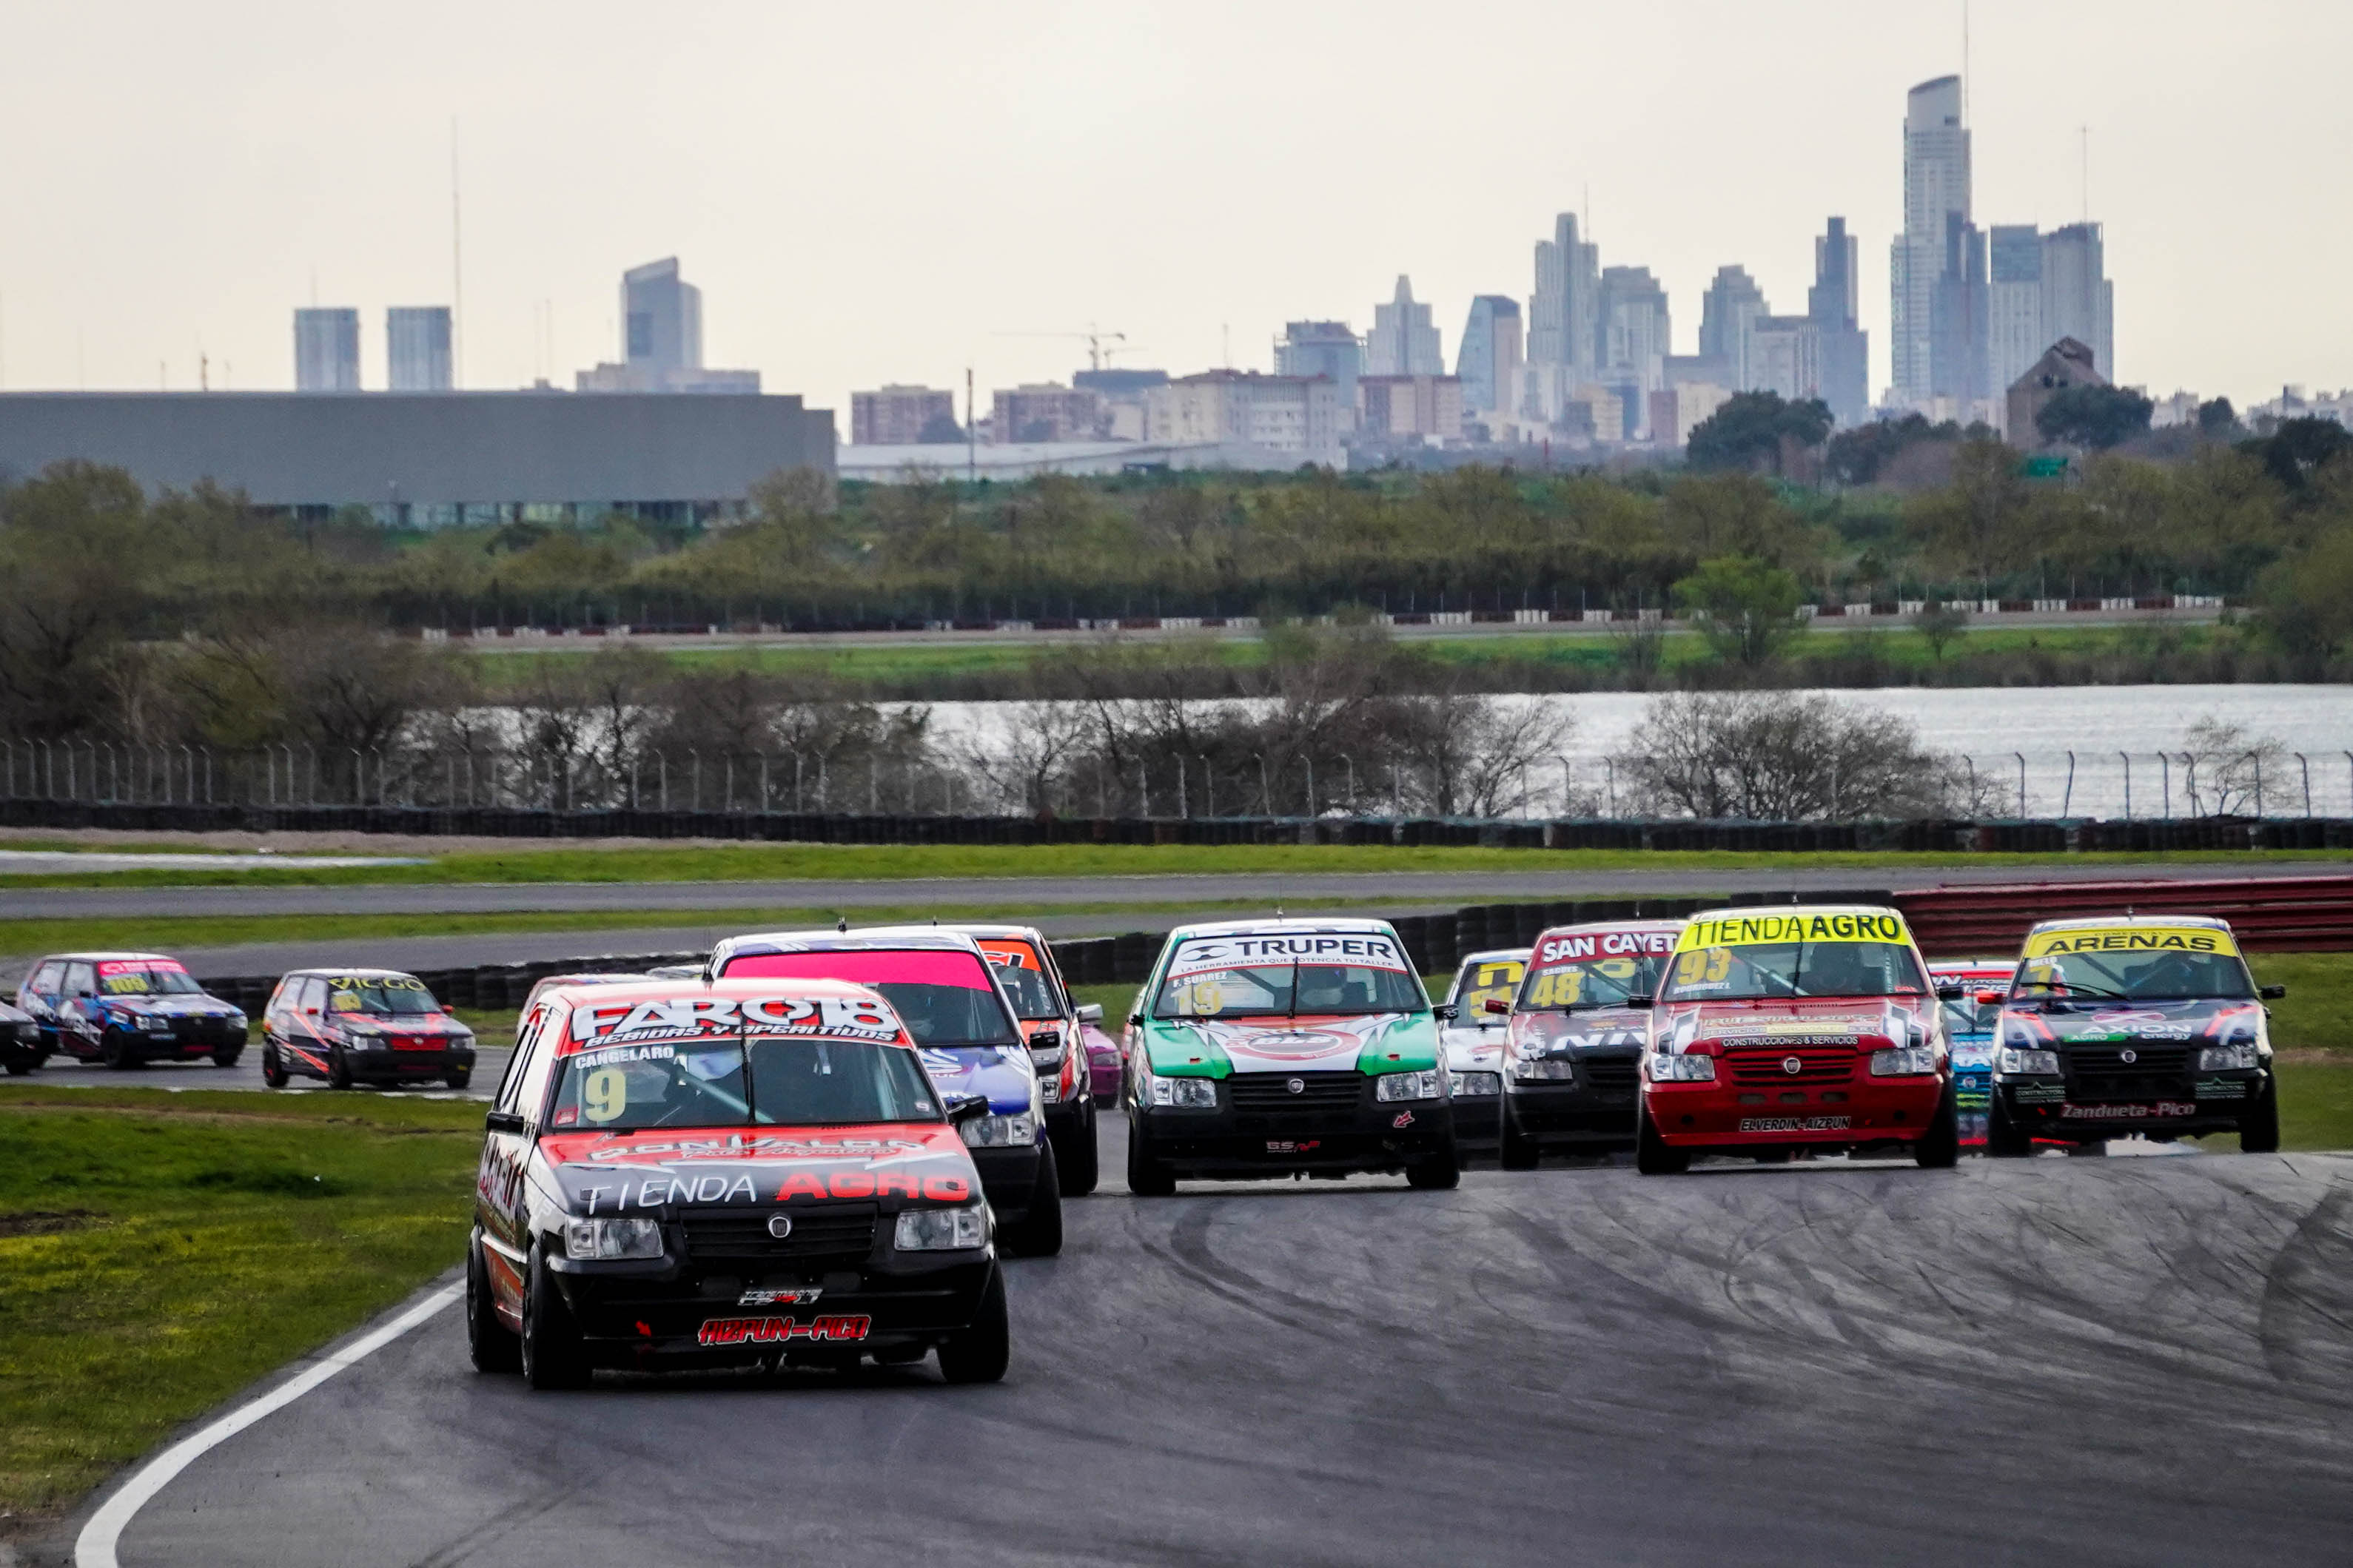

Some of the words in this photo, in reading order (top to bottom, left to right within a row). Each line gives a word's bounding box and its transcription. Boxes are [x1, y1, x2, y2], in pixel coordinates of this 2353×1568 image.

[1694, 916, 1805, 946] TIENDA
[1810, 915, 1901, 941] AGRO
[1235, 939, 1393, 959] TRUPER
[1543, 936, 1595, 963] SAN
[2043, 935, 2216, 955] ARENAS
[1195, 959, 1266, 970] HERRAMIENTA
[1677, 948, 1732, 986] 93
[1184, 972, 1228, 986] SUAREZ
[1530, 972, 1586, 1007] 48
[1170, 982, 1224, 1015] 19
[584, 1026, 705, 1049] BEBIDAS
[711, 1025, 729, 1036] Y
[735, 1024, 896, 1042] APERITIVOS
[1722, 1037, 1803, 1047] CONSTRUCCIONES
[1804, 1036, 1810, 1044] &
[1812, 1035, 1859, 1045] SERVICIOS
[2081, 1024, 2192, 1034] AXION
[2141, 1032, 2192, 1041] energy
[575, 1046, 674, 1070] CANGELARO
[585, 1069, 627, 1123] 9
[583, 1175, 758, 1215] TIENDA
[776, 1172, 971, 1202] AGRO
